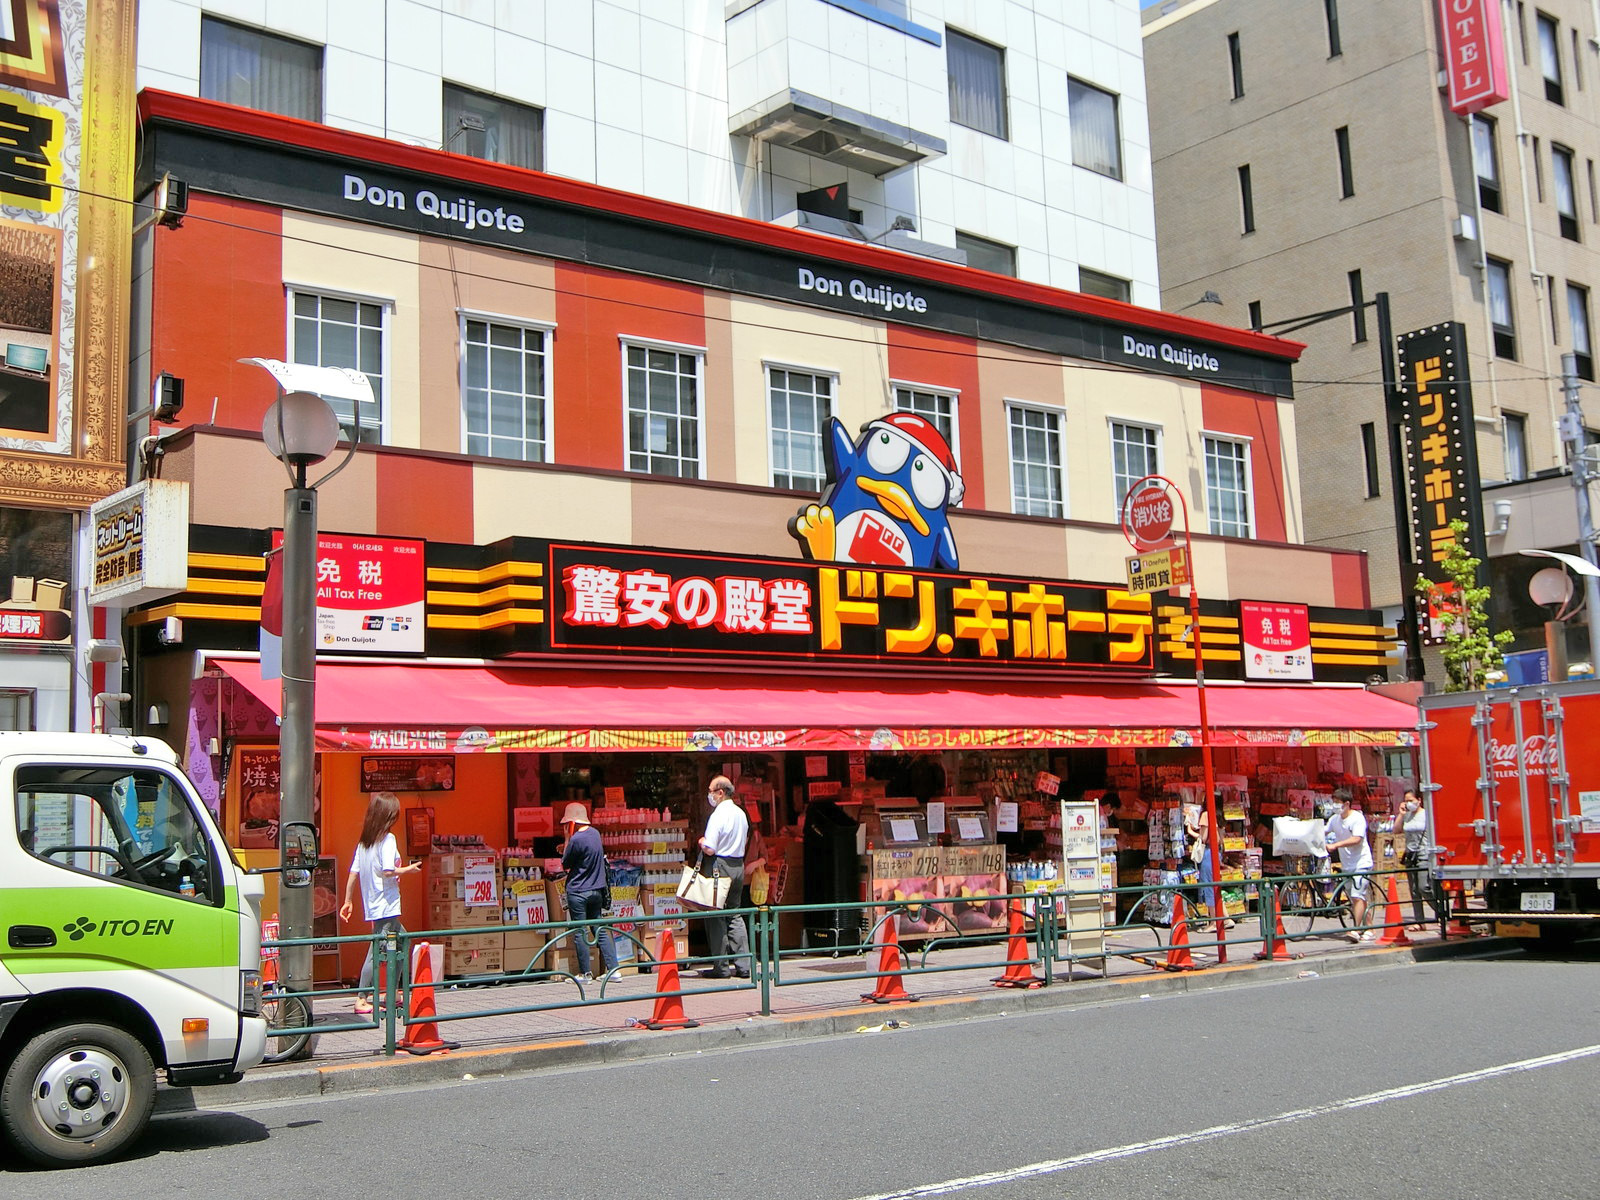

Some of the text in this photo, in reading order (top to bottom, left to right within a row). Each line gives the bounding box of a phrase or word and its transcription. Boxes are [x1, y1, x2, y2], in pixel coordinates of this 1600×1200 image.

[344, 175, 525, 233] Don Quijote
[799, 268, 928, 312] Don Quijote
[1123, 335, 1219, 371] Don Quijote
[1133, 500, 1171, 528] 消火栓
[317, 557, 382, 586] 免税
[1130, 559, 1141, 575] P
[1132, 569, 1171, 592] 時間貸
[317, 588, 382, 600] All Tax Free
[569, 564, 812, 634] 驚安の殿堂
[0, 615, 40, 634] 煙所
[369, 730, 447, 749] 欢迎光临
[496, 729, 568, 748] WELCOME
[571, 731, 586, 747] to
[723, 730, 787, 747] 어서오세요
[914, 857, 939, 876] 278
[981, 854, 1002, 873] 148
[473, 881, 492, 902] 298
[527, 907, 545, 924] 1280
[98, 919, 174, 936] ITO EN
